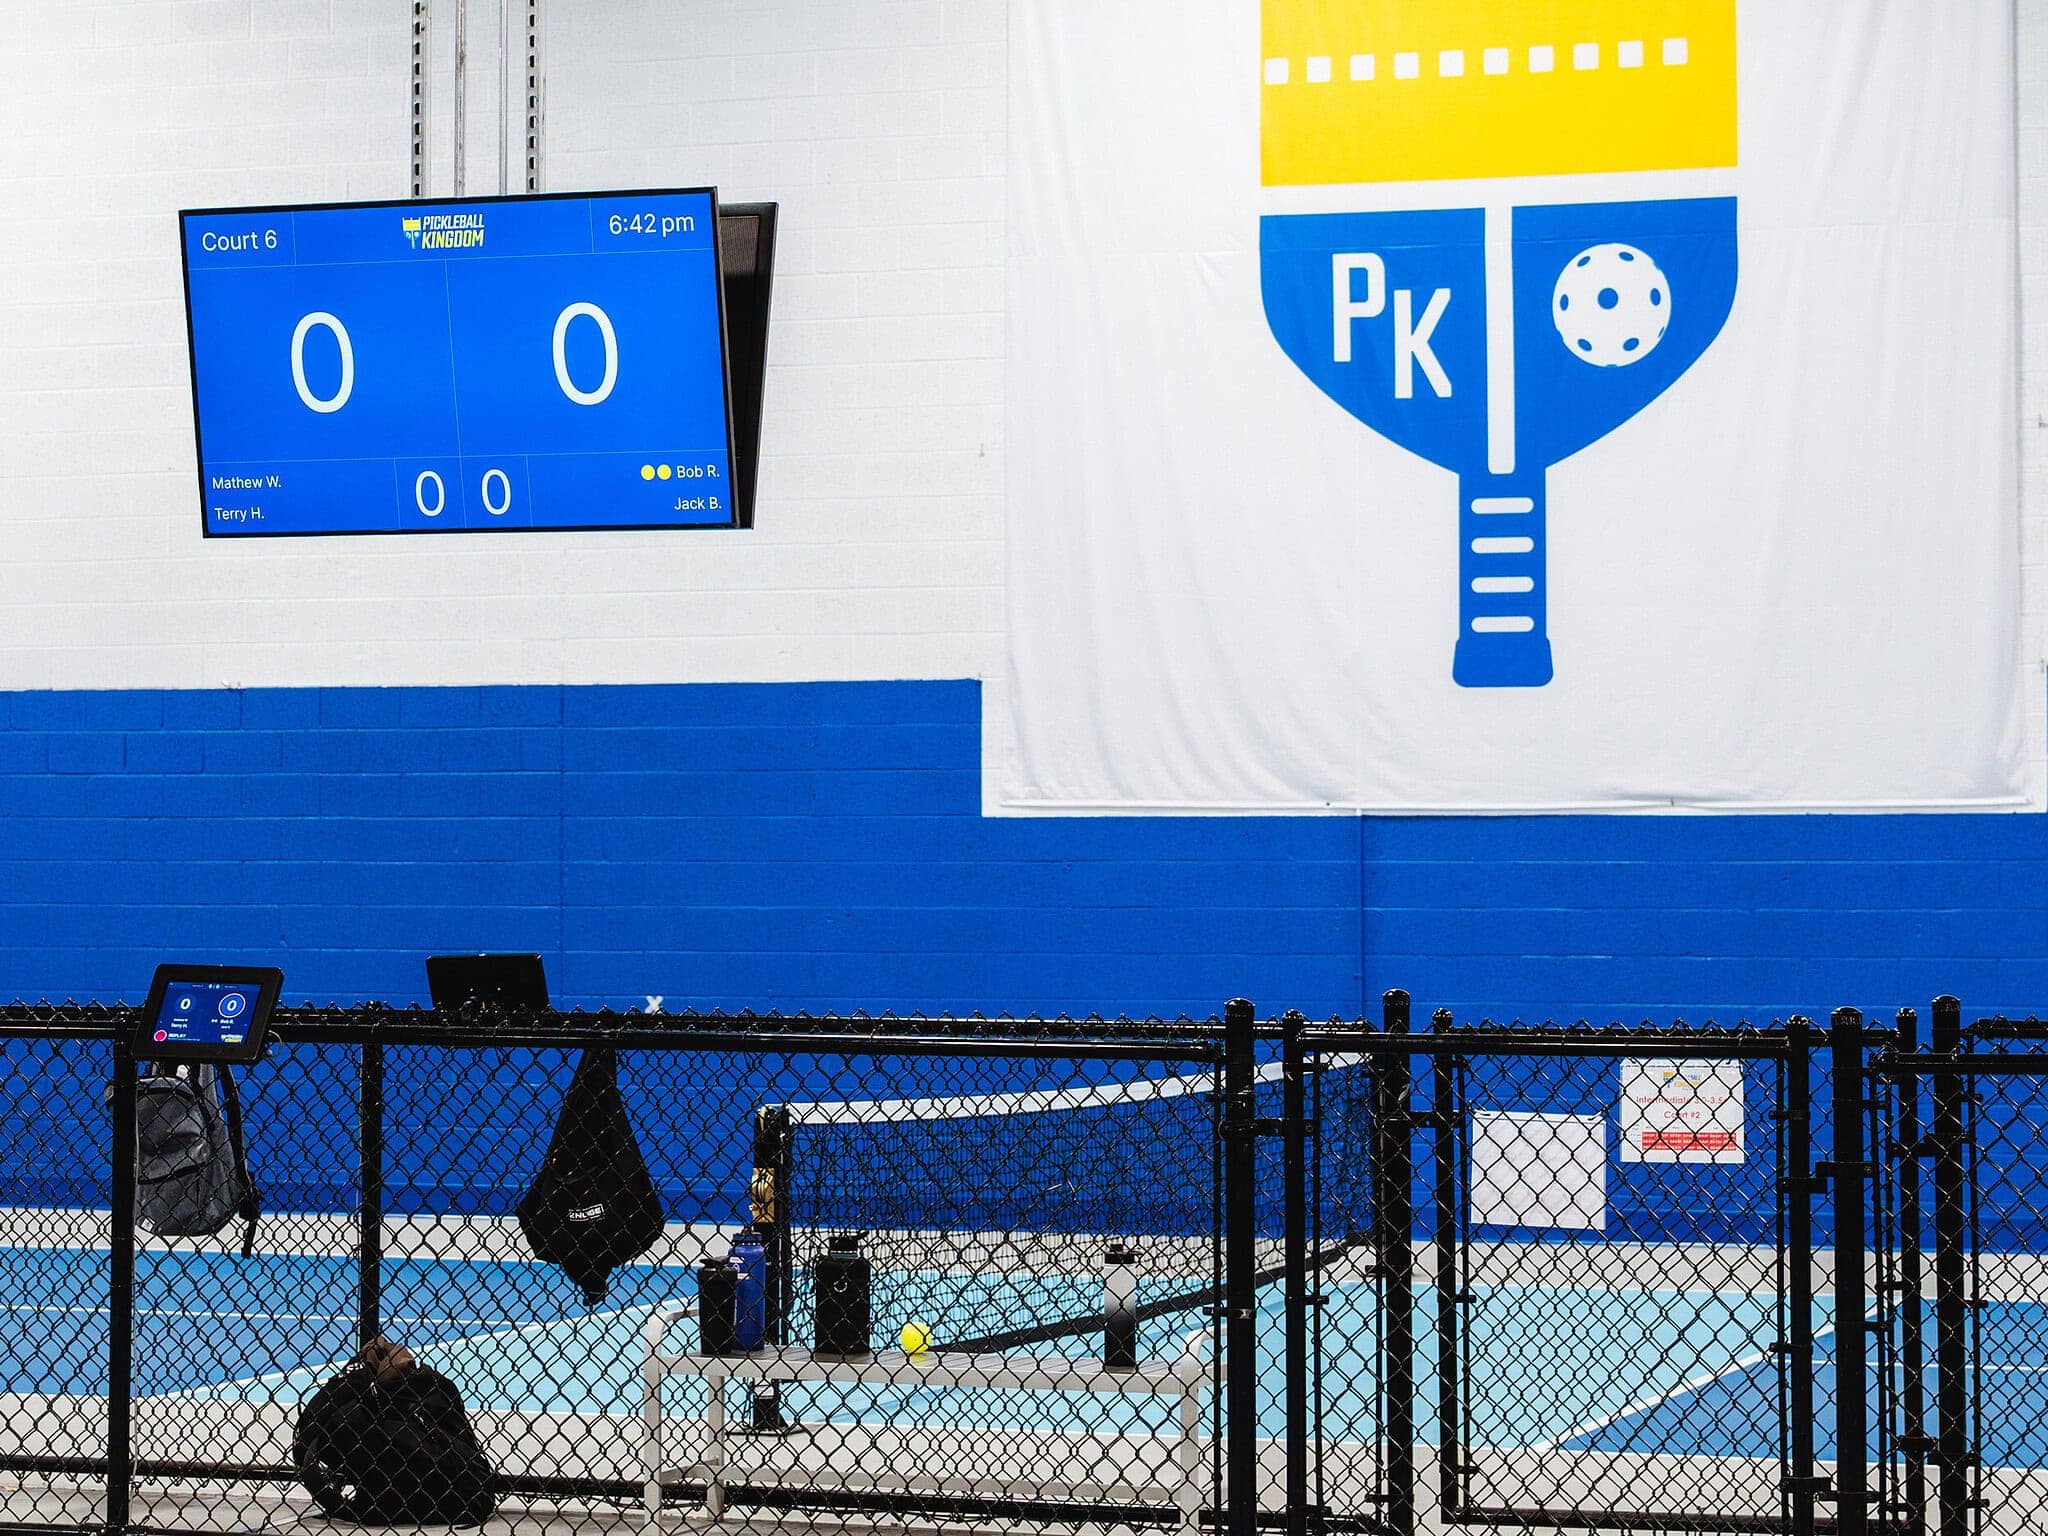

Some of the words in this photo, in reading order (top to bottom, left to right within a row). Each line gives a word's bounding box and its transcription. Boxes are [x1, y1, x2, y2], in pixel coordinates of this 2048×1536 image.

[422, 213, 485, 230] PICKLEBALL
[610, 214, 656, 234] 6:42
[662, 217, 694, 237] pm
[203, 232, 258, 251] Court
[265, 230, 276, 248] 6
[420, 229, 485, 249] KINGDOM
[291, 312, 353, 412] 0
[553, 303, 617, 405] 0
[677, 466, 703, 478] Bob
[708, 465, 719, 476] R.
[213, 477, 262, 489] Mathew
[266, 476, 281, 487] W.
[416, 471, 444, 516] 0
[482, 469, 510, 514] 0
[675, 497, 705, 509] Jack
[710, 497, 721, 509] B.
[215, 508, 247, 522] Terry
[252, 507, 264, 518] H.
[180, 998, 191, 1010] 0
[227, 1000, 237, 1011] 0
[1636, 1096, 1691, 1104] Intemediat
[1663, 1111, 1688, 1119] Cort
